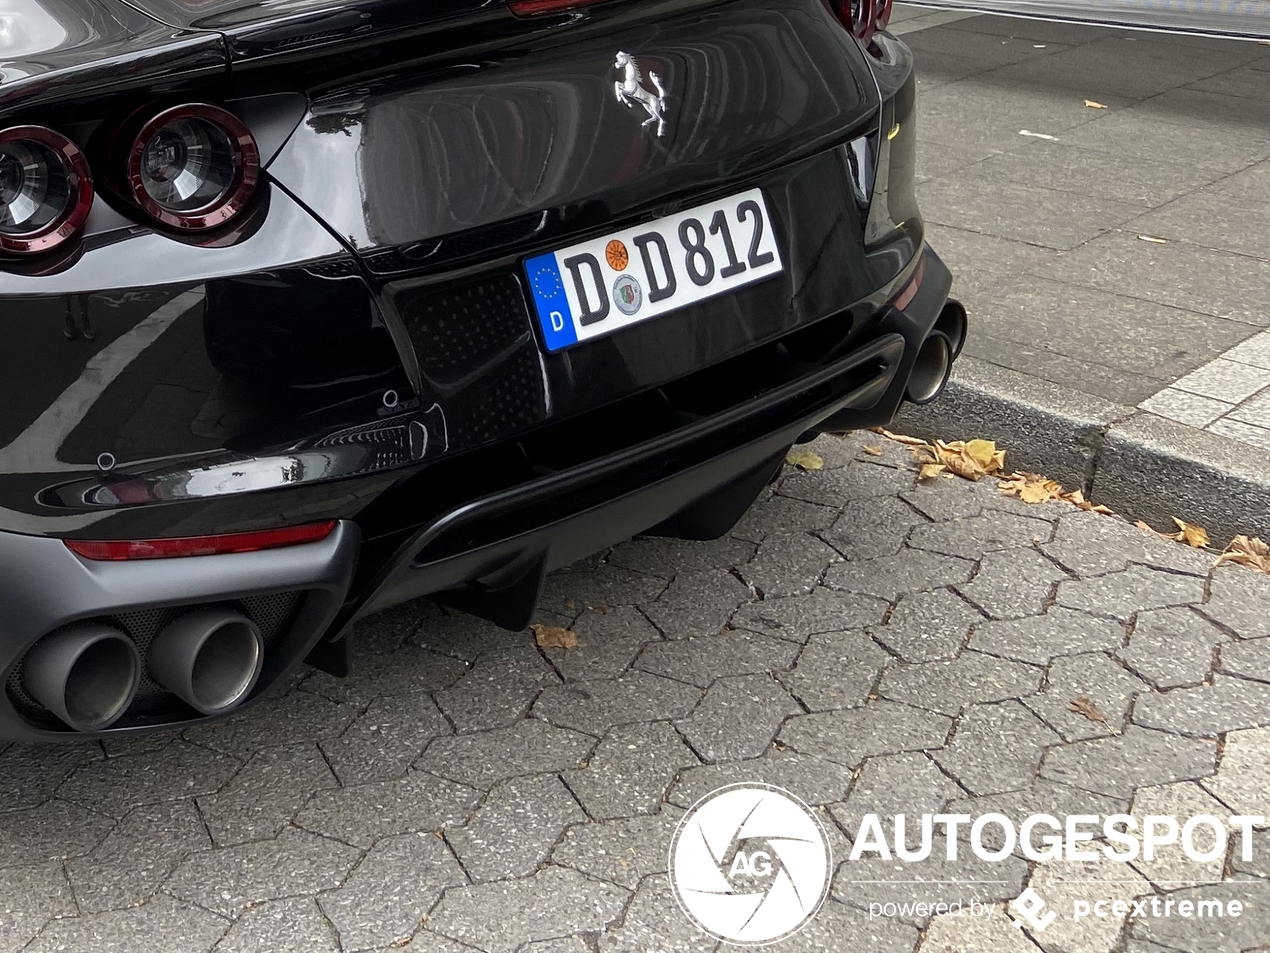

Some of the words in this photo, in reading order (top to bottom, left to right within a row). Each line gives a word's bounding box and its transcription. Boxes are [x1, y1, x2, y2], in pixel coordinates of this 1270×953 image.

[564, 252, 611, 327] D
[633, 231, 677, 303] D
[678, 199, 775, 287] 812
[550, 311, 564, 332] D
